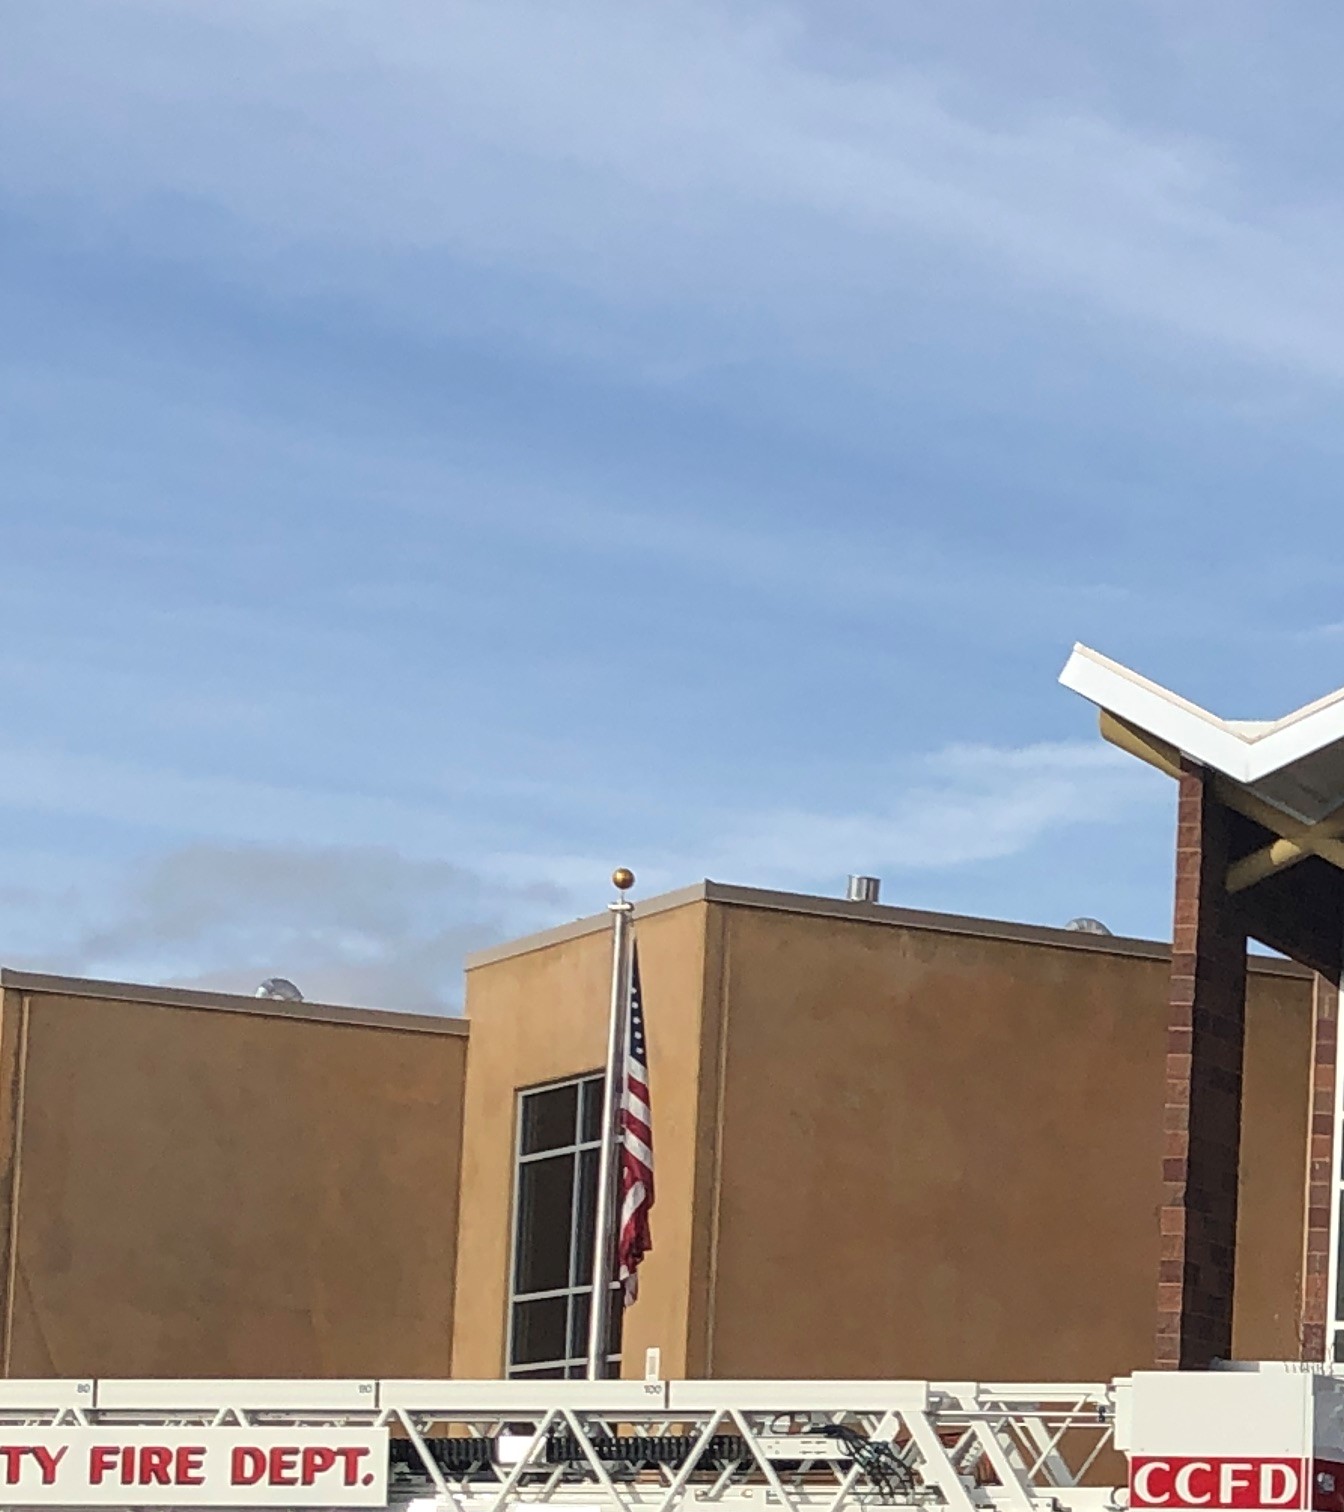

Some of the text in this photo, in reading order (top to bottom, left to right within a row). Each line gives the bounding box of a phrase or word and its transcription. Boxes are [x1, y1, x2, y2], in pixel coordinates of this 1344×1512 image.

[89, 1446, 207, 1486] FIRE
[230, 1446, 375, 1487] DEPT.
[1134, 1461, 1298, 1504] CCFD
